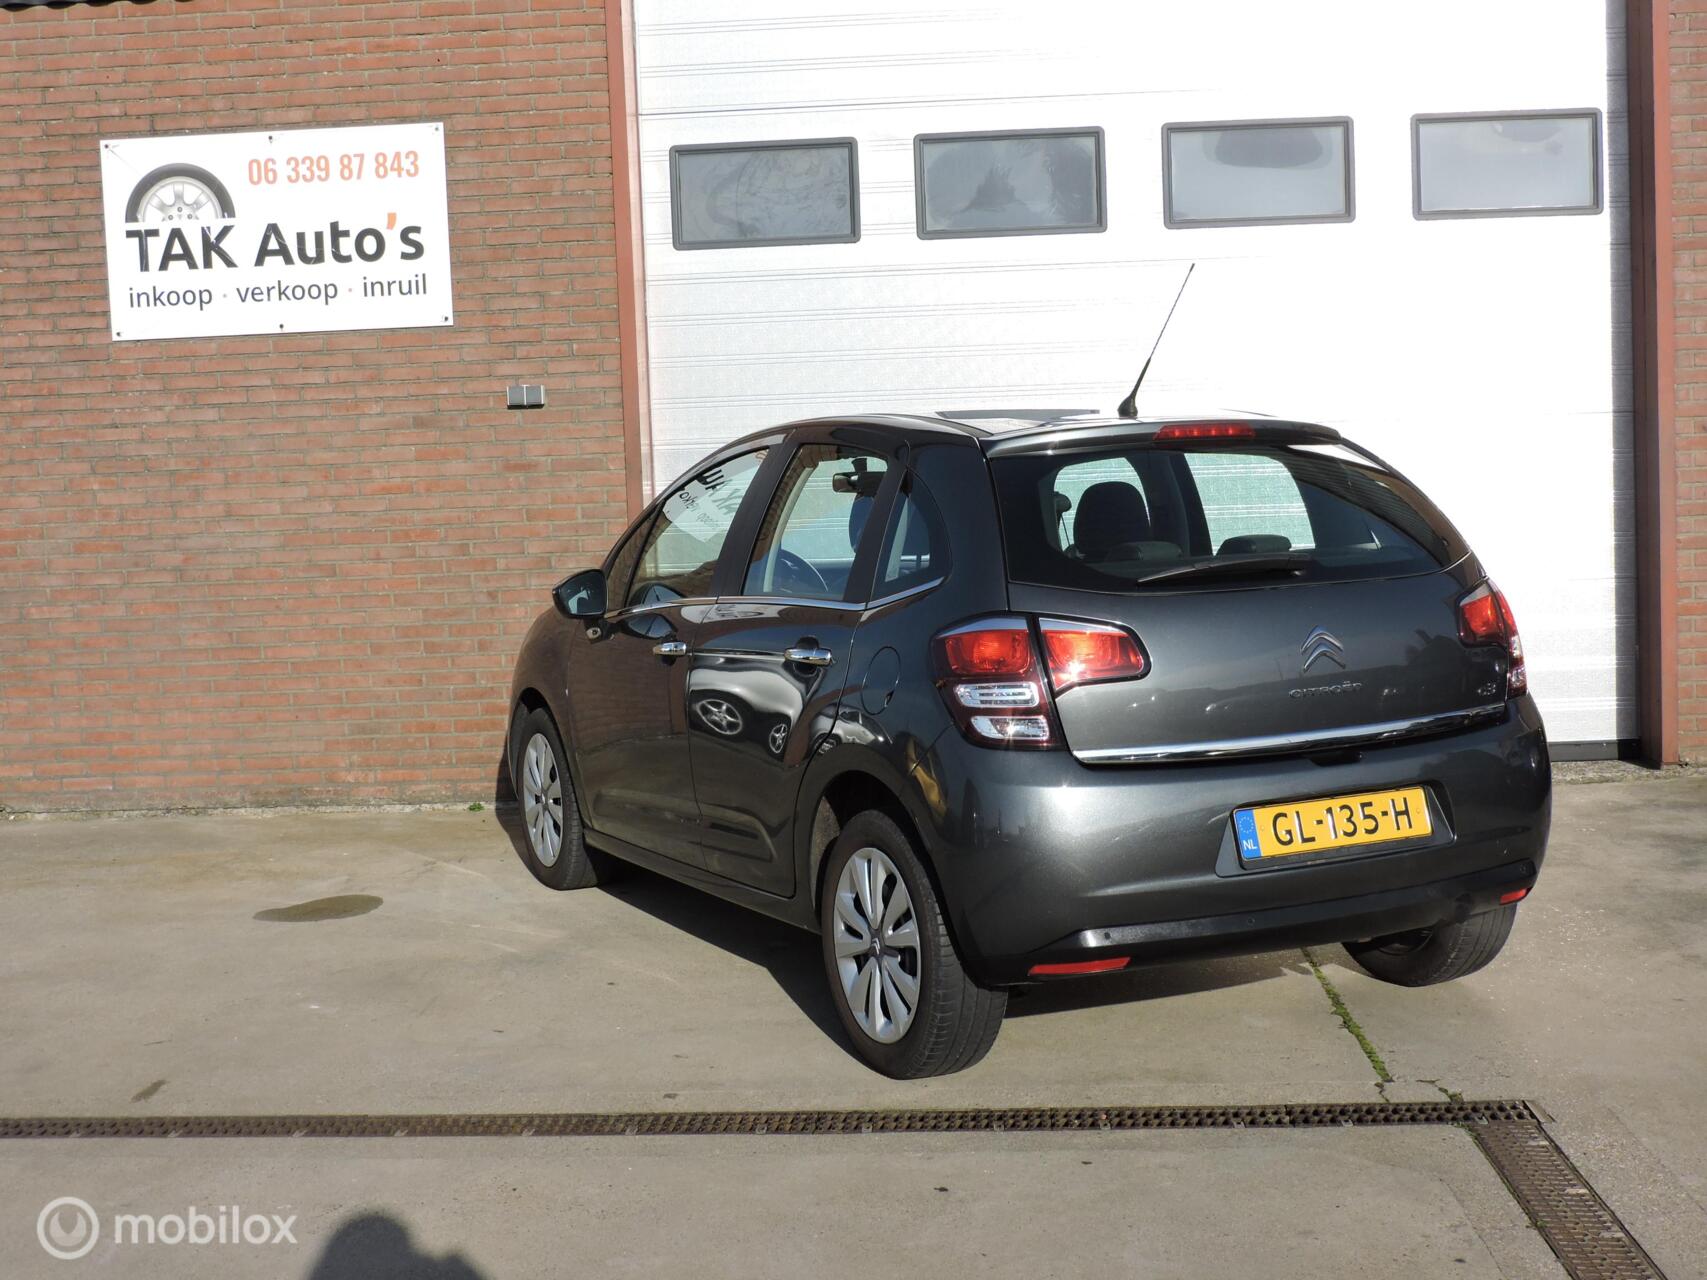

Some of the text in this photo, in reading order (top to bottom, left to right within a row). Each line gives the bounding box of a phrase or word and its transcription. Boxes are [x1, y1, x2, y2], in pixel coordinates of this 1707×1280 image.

[248, 150, 420, 185] 06 339 87 843
[125, 212, 425, 273] TAK Auto's
[128, 273, 427, 311] inkoop verkoop inruil
[1243, 839, 1258, 851] NL
[1272, 797, 1413, 846] GL-135-H
